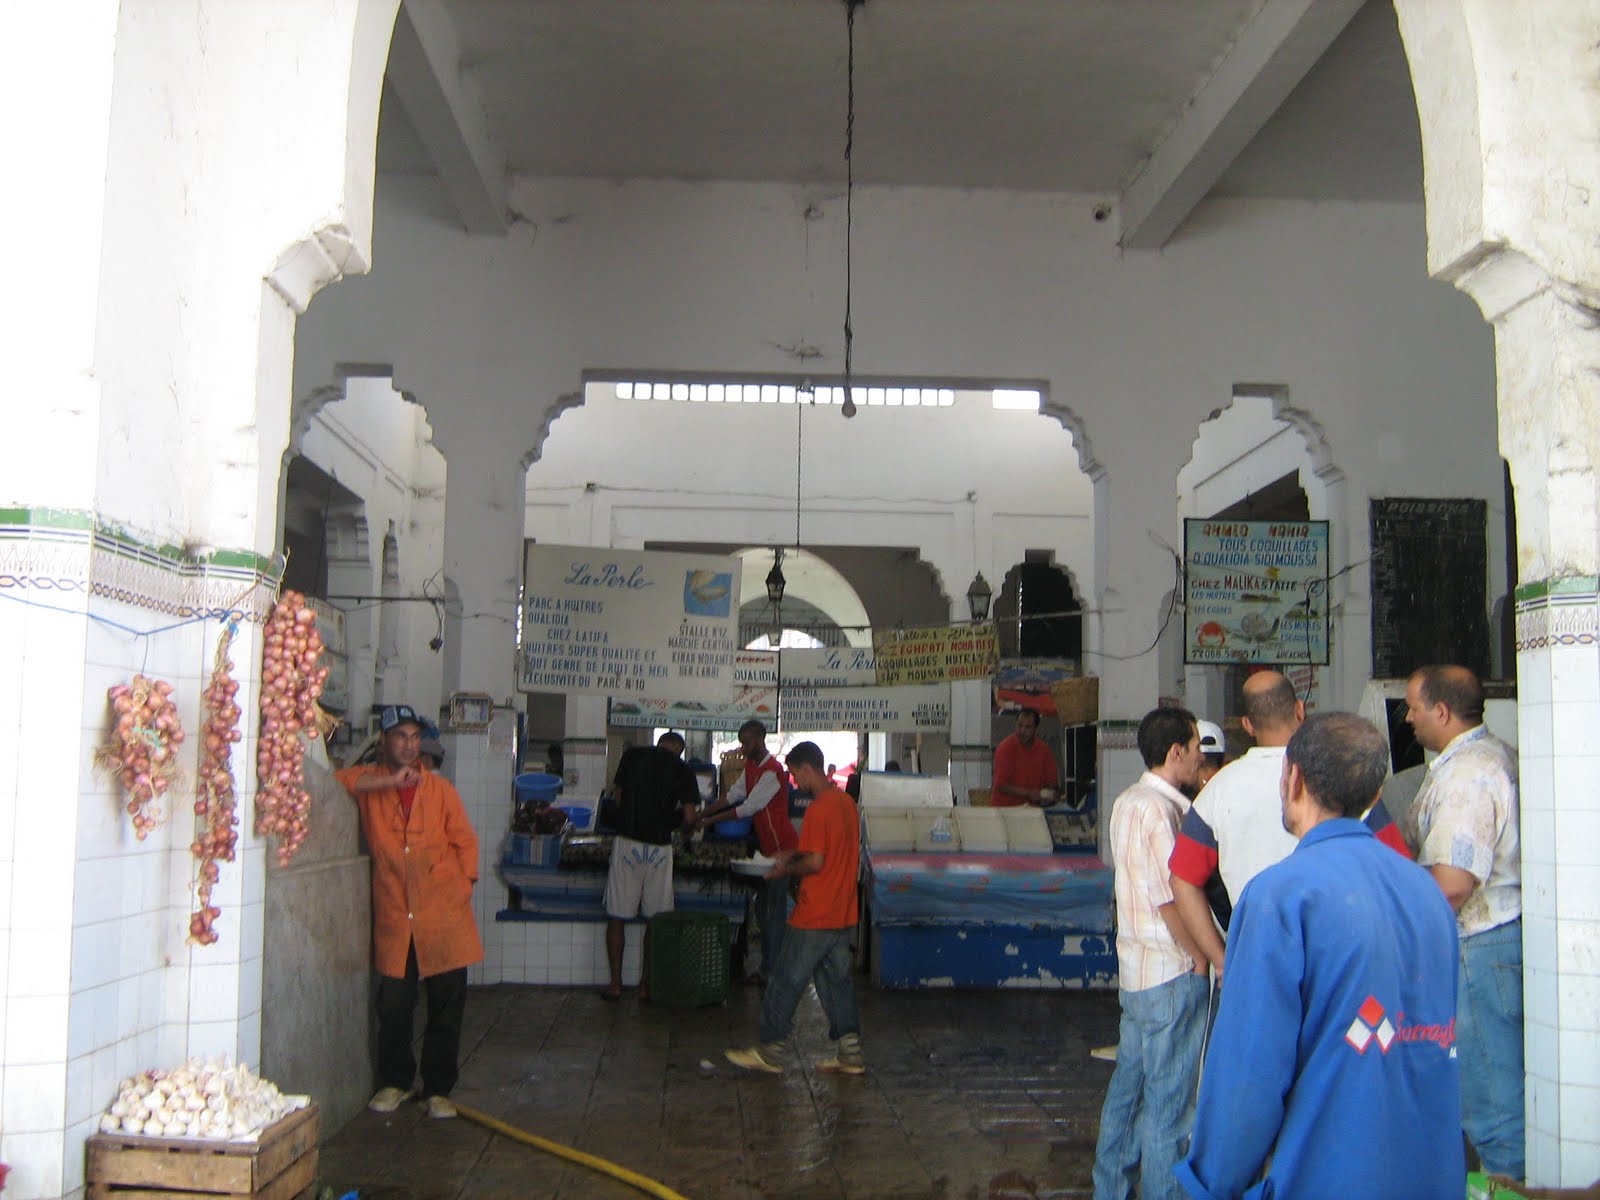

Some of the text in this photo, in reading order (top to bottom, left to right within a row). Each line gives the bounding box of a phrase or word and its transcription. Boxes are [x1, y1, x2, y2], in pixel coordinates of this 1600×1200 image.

[1388, 503, 1469, 513] POISSONS
[1219, 539, 1246, 550] TOUS
[564, 561, 655, 589] La Perle
[1191, 580, 1220, 589] CHEZ
[529, 597, 551, 609] PARC
[548, 629, 608, 643] CHEZ LATIFA
[680, 625, 709, 637] STALLE
[568, 645, 597, 657] SUPER
[817, 650, 840, 670] La
[552, 659, 580, 672] GENRE
[586, 661, 597, 673] DE
[602, 662, 628, 675] FRUIT
[633, 665, 644, 676] DE
[649, 665, 668, 677] MER
[597, 677, 620, 689] PARC
[818, 700, 843, 709] SUPER
[805, 711, 830, 720] GENRE
[832, 711, 841, 720] DE
[844, 711, 867, 720] FRUIT
[870, 711, 880, 720] DE
[883, 711, 898, 720] MER
[842, 722, 861, 730] PARC
